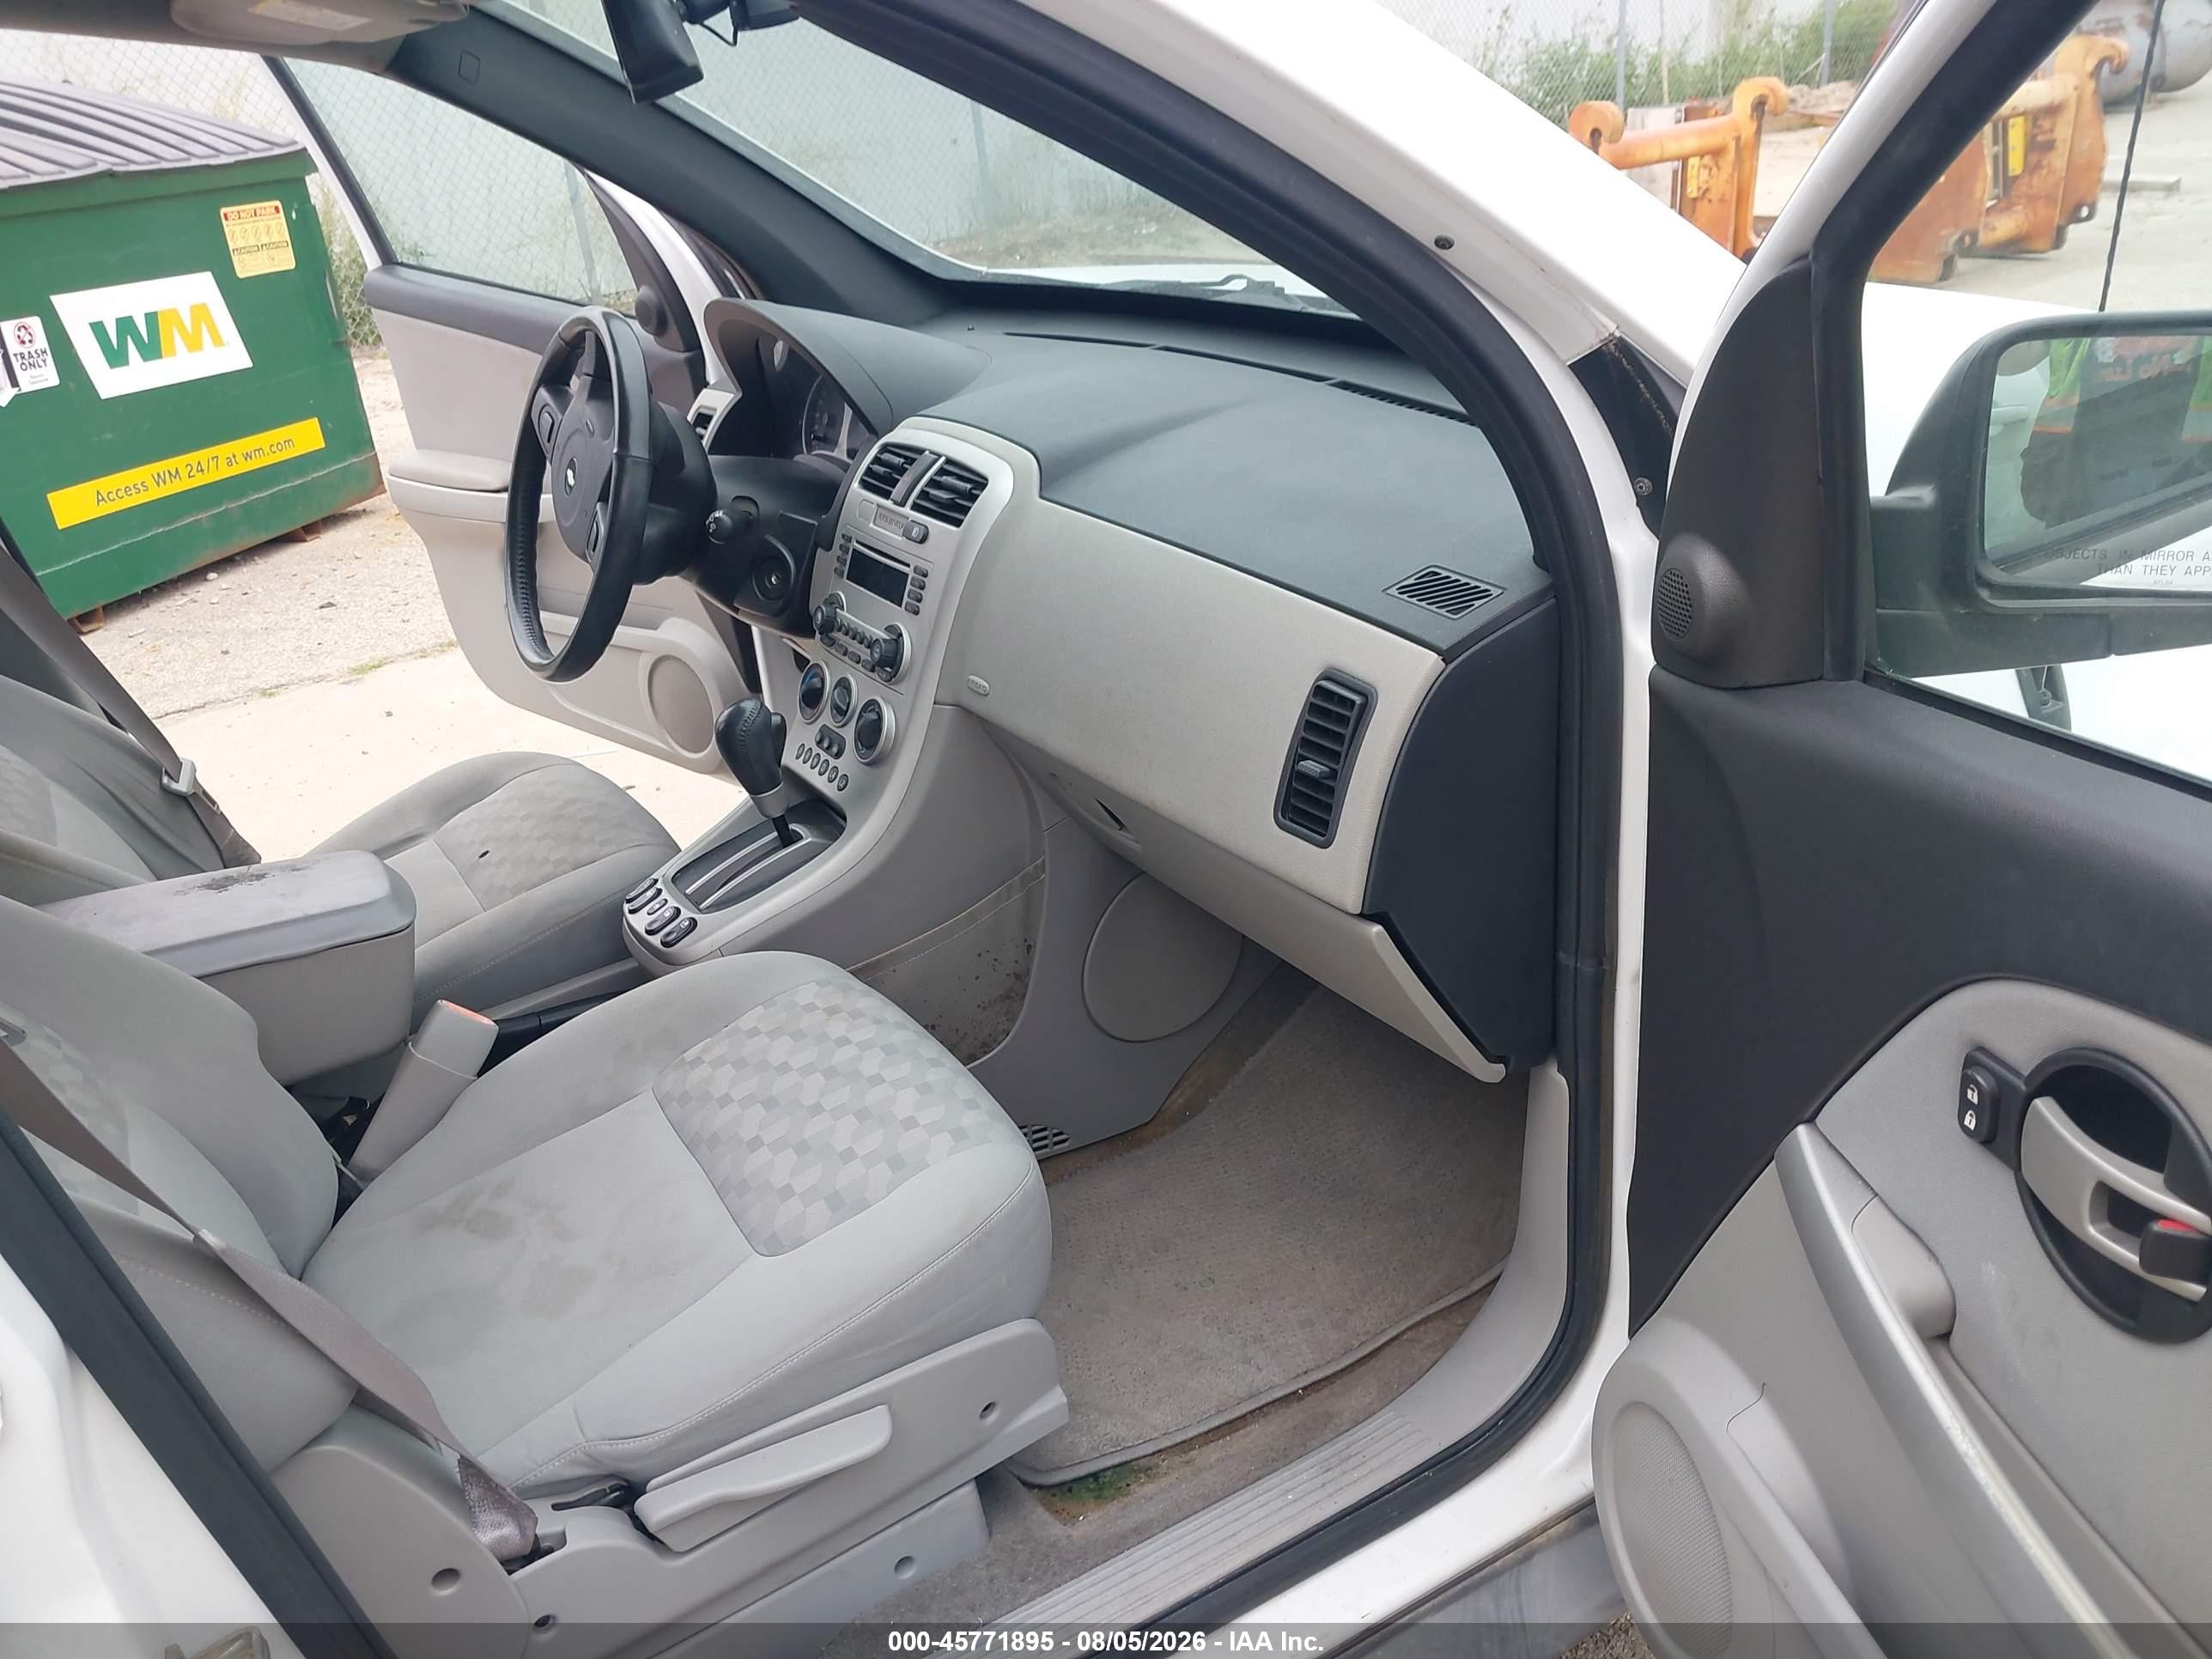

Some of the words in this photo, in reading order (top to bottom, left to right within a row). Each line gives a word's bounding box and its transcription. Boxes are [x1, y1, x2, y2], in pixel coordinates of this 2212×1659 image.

[88, 302, 226, 369] WM
[13, 348, 48, 363] TRASH
[20, 358, 47, 372] ONLY
[95, 480, 149, 507] Access
[151, 468, 182, 488] WM
[185, 455, 221, 479] 24/7
[225, 453, 240, 467] at
[241, 437, 295, 462] wm.com
[2141, 550, 2195, 562] MIRROR
[2201, 550, 2212, 562] A
[2096, 563, 2133, 575] THAN
[2142, 564, 2177, 576] THEY
[2184, 565, 2212, 577] APP
